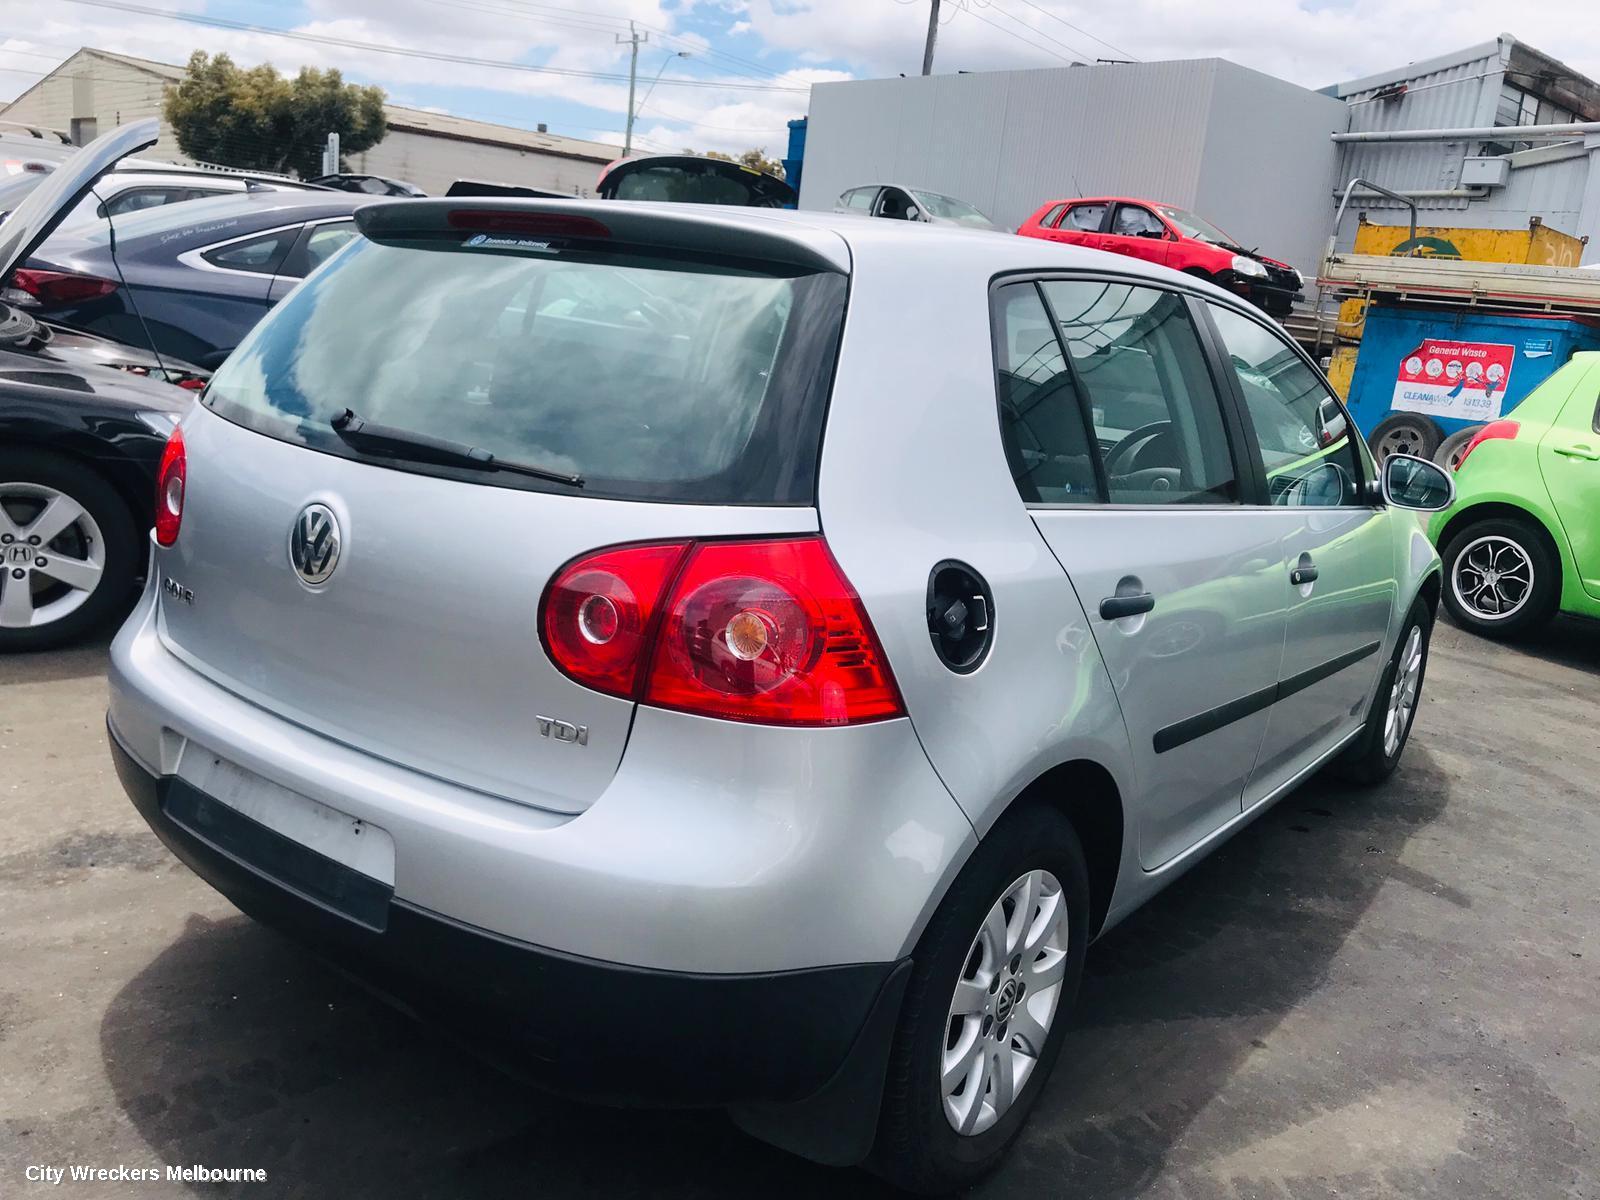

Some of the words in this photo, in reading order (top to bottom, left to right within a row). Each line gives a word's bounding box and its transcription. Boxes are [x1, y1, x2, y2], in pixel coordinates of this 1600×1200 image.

[1429, 345, 1459, 356] General
[1461, 347, 1487, 358] Waste
[535, 714, 588, 747] TDI
